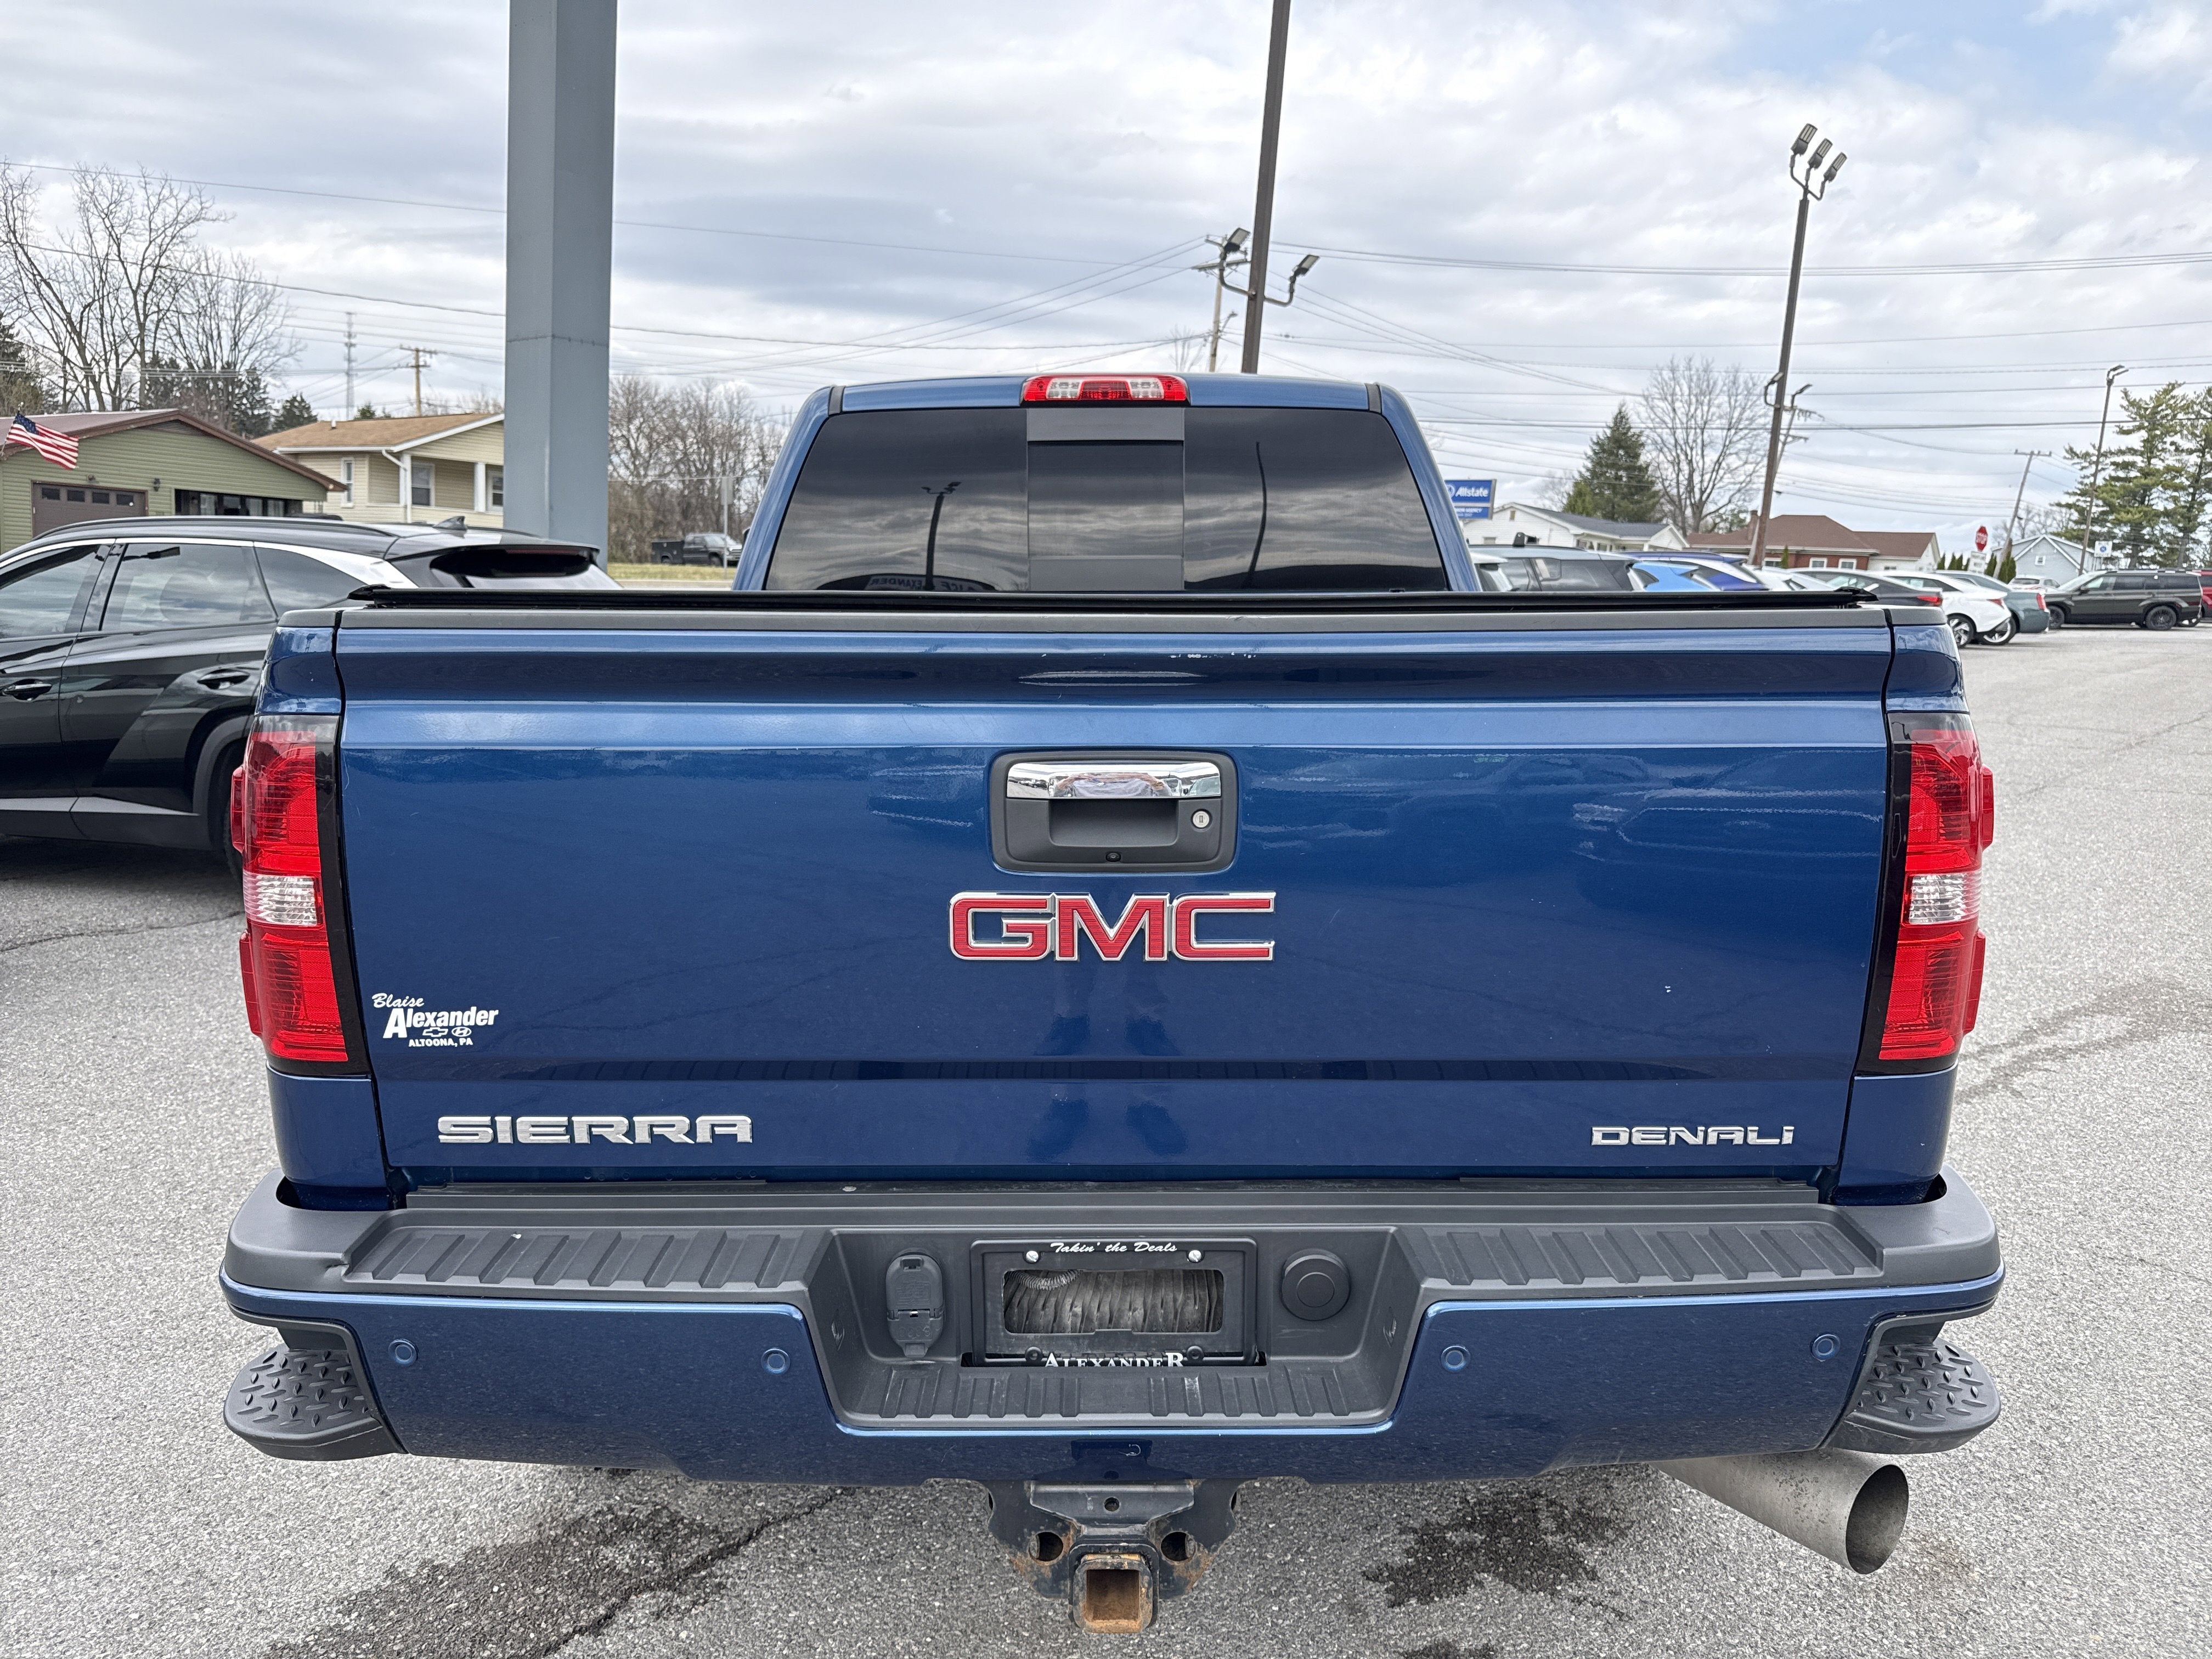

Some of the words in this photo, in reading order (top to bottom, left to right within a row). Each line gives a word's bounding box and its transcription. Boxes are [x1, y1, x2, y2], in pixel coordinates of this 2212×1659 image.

[1455, 487, 1489, 497] Allstate
[1976, 532, 1988, 545] STOP
[949, 891, 1276, 961] GMC
[371, 992, 425, 1008] Blaise
[382, 1006, 499, 1039] Alexander
[408, 1038, 458, 1047] ALTOONA,
[459, 1037, 473, 1046] PA
[438, 1115, 754, 1144] SIERRA
[1591, 1126, 1795, 1146] DENALI
[1050, 1242, 1101, 1253] Takin'
[1105, 1242, 1128, 1253] the
[1133, 1242, 1178, 1252] Deals
